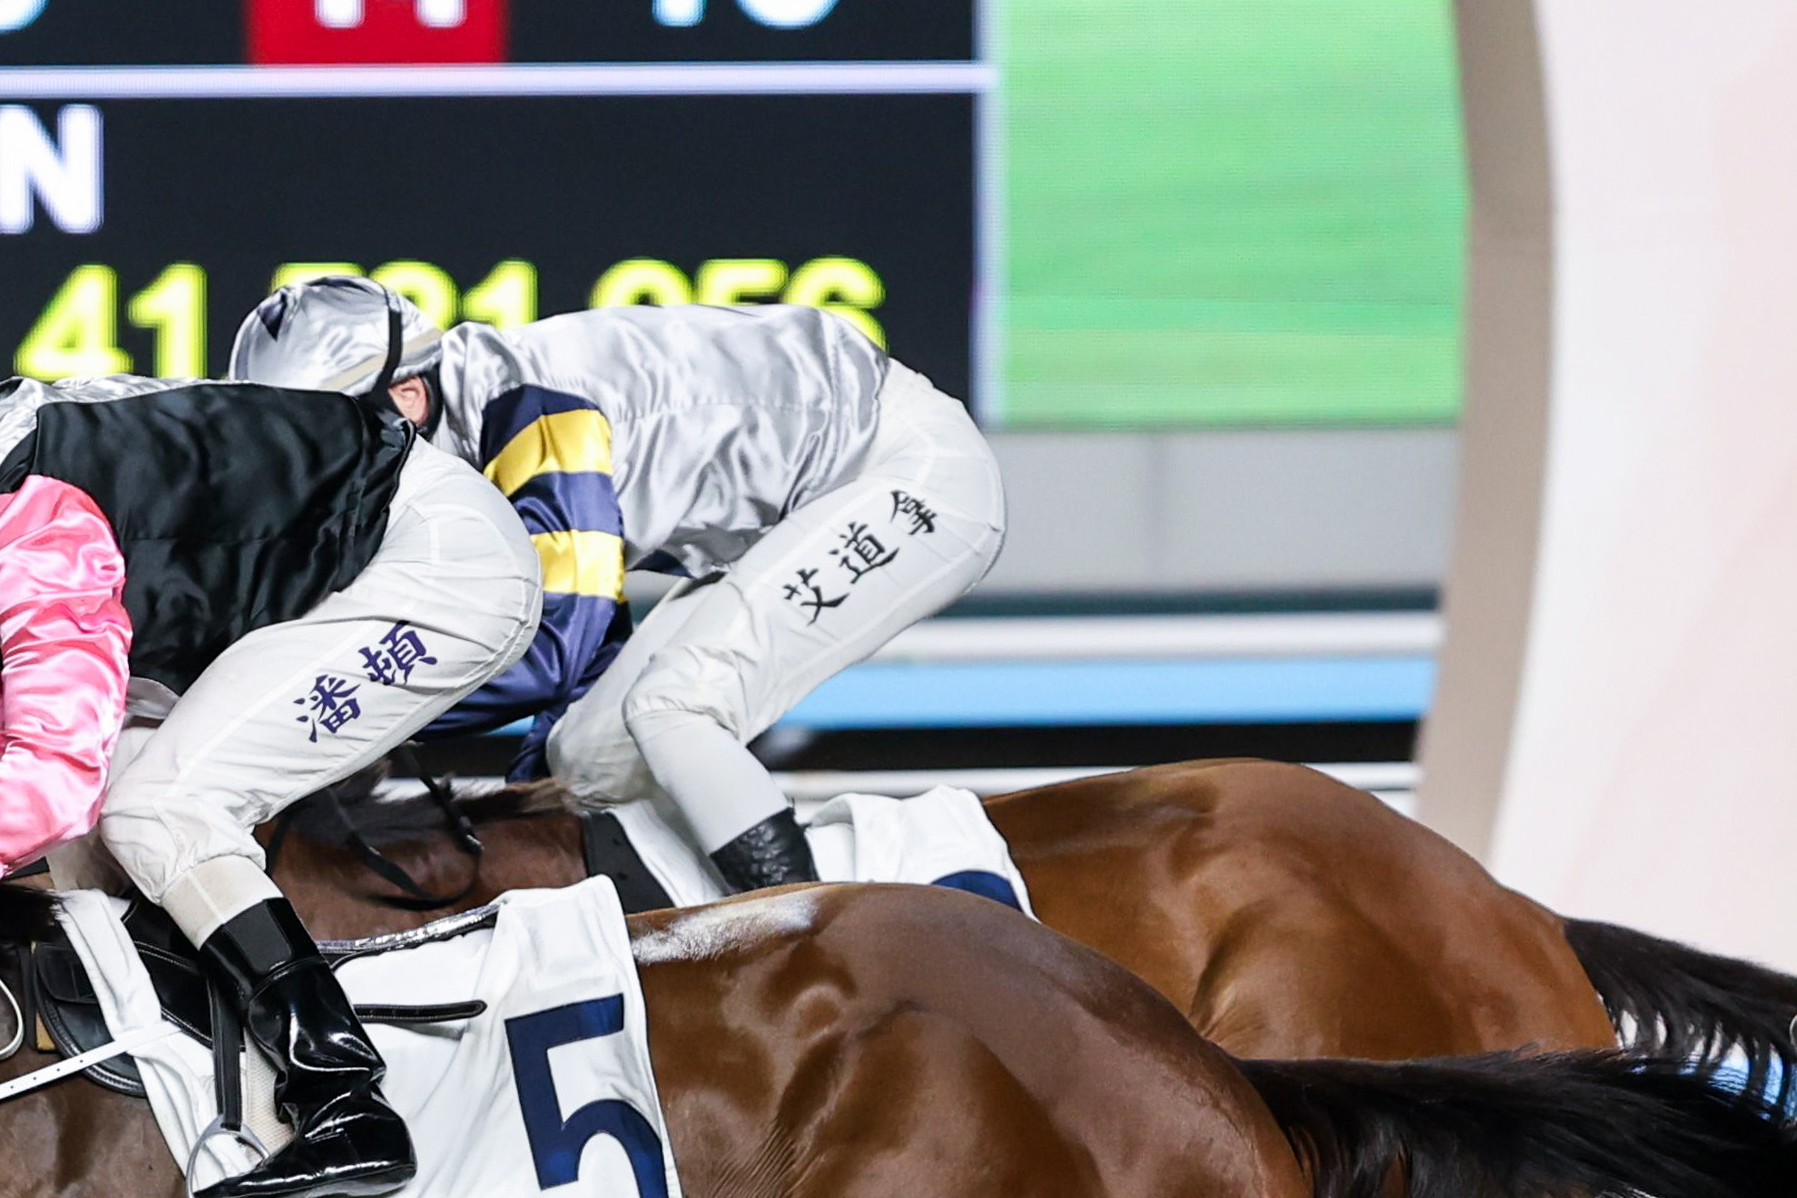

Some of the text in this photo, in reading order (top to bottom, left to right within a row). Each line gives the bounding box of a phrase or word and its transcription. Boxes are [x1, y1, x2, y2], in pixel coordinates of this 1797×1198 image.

[782, 489, 937, 626] 艾道拿
[293, 620, 438, 743] 潘頓
